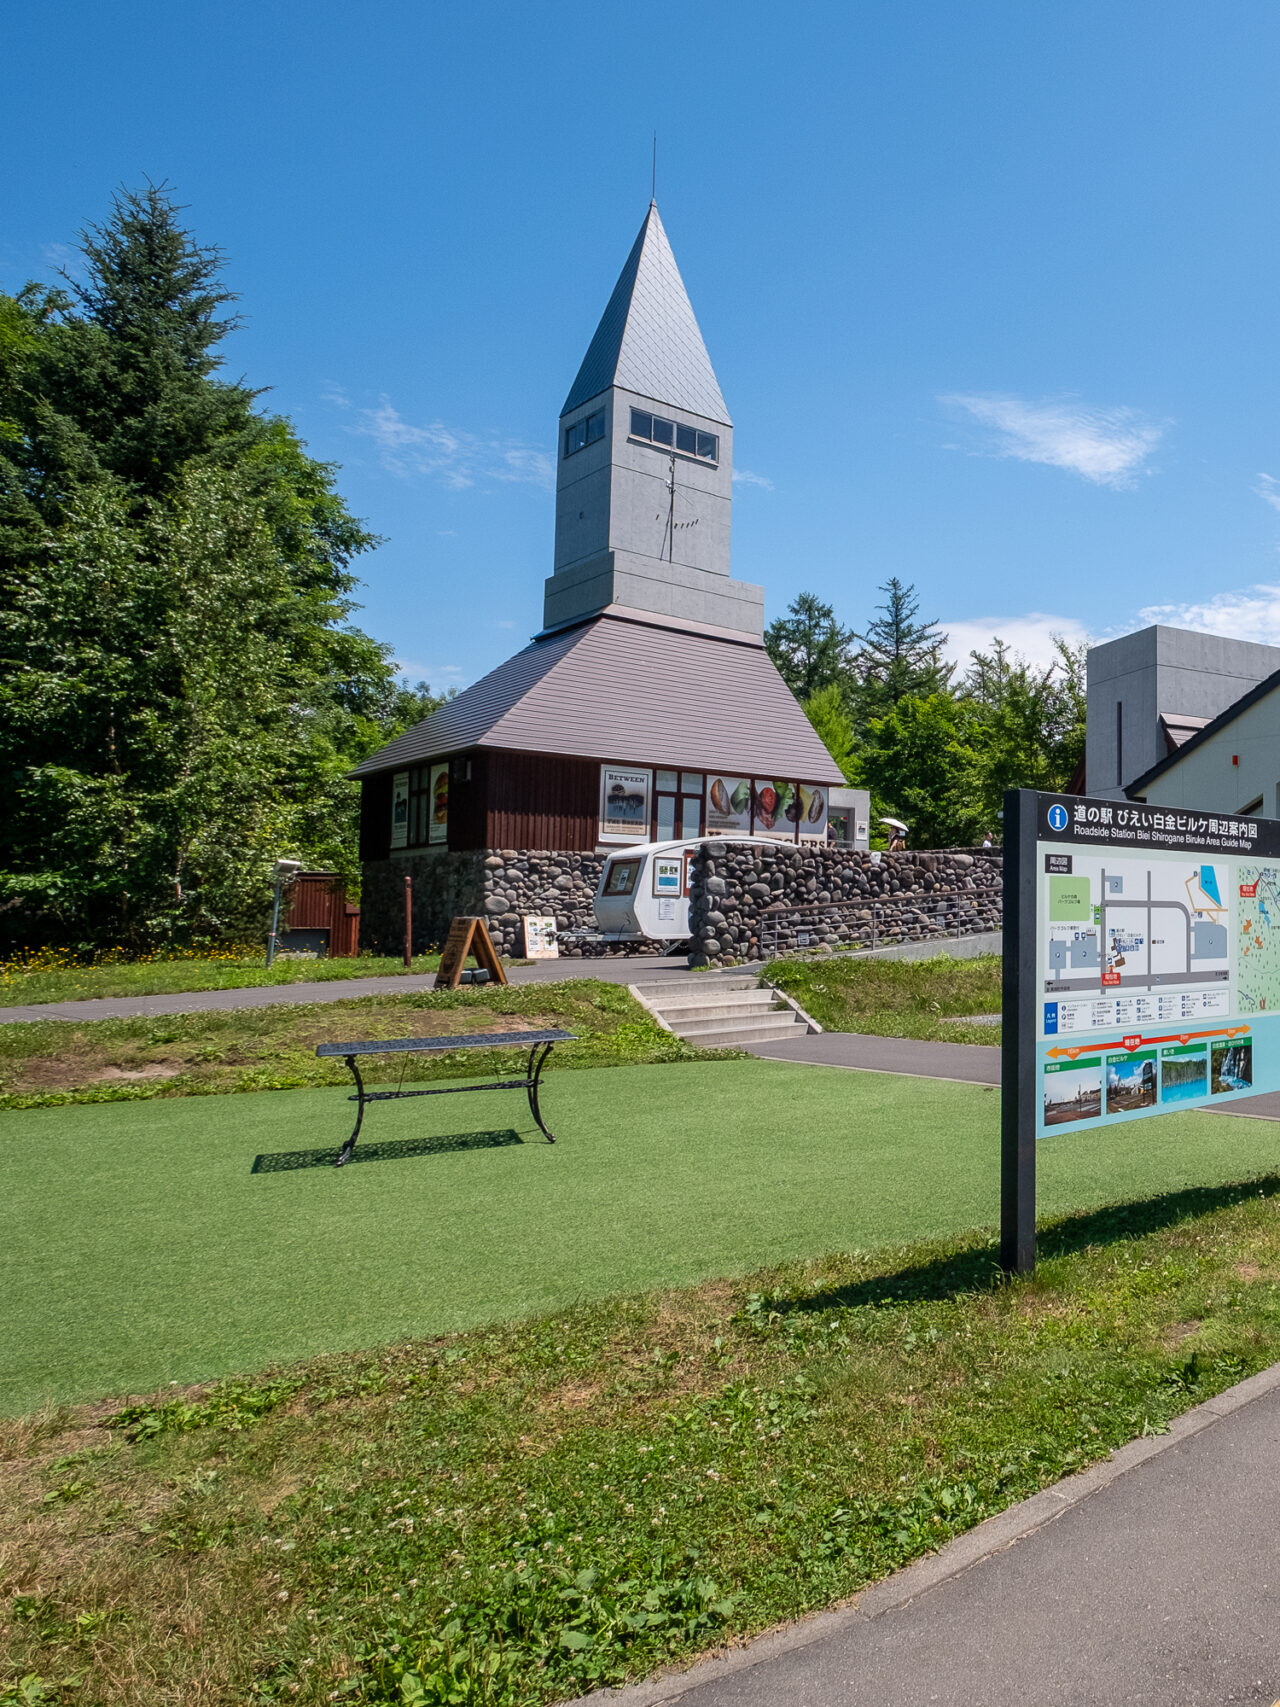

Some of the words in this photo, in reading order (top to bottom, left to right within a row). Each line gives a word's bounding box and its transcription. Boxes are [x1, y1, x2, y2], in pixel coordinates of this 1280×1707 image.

[608, 773, 646, 783] BETWEEN
[1074, 804, 1113, 825] 道の駅
[1117, 809, 1258, 839] びえい白金ビルケ周辺案内図
[1074, 824, 1109, 838] Roadside
[1111, 828, 1136, 840] Station
[1137, 830, 1150, 840] Biei
[1152, 831, 1184, 844] Shirogane
[1186, 834, 1205, 845] Biruke
[1206, 836, 1220, 846] Area
[1221, 837, 1238, 848] Guide
[1239, 838, 1252, 850] Map
